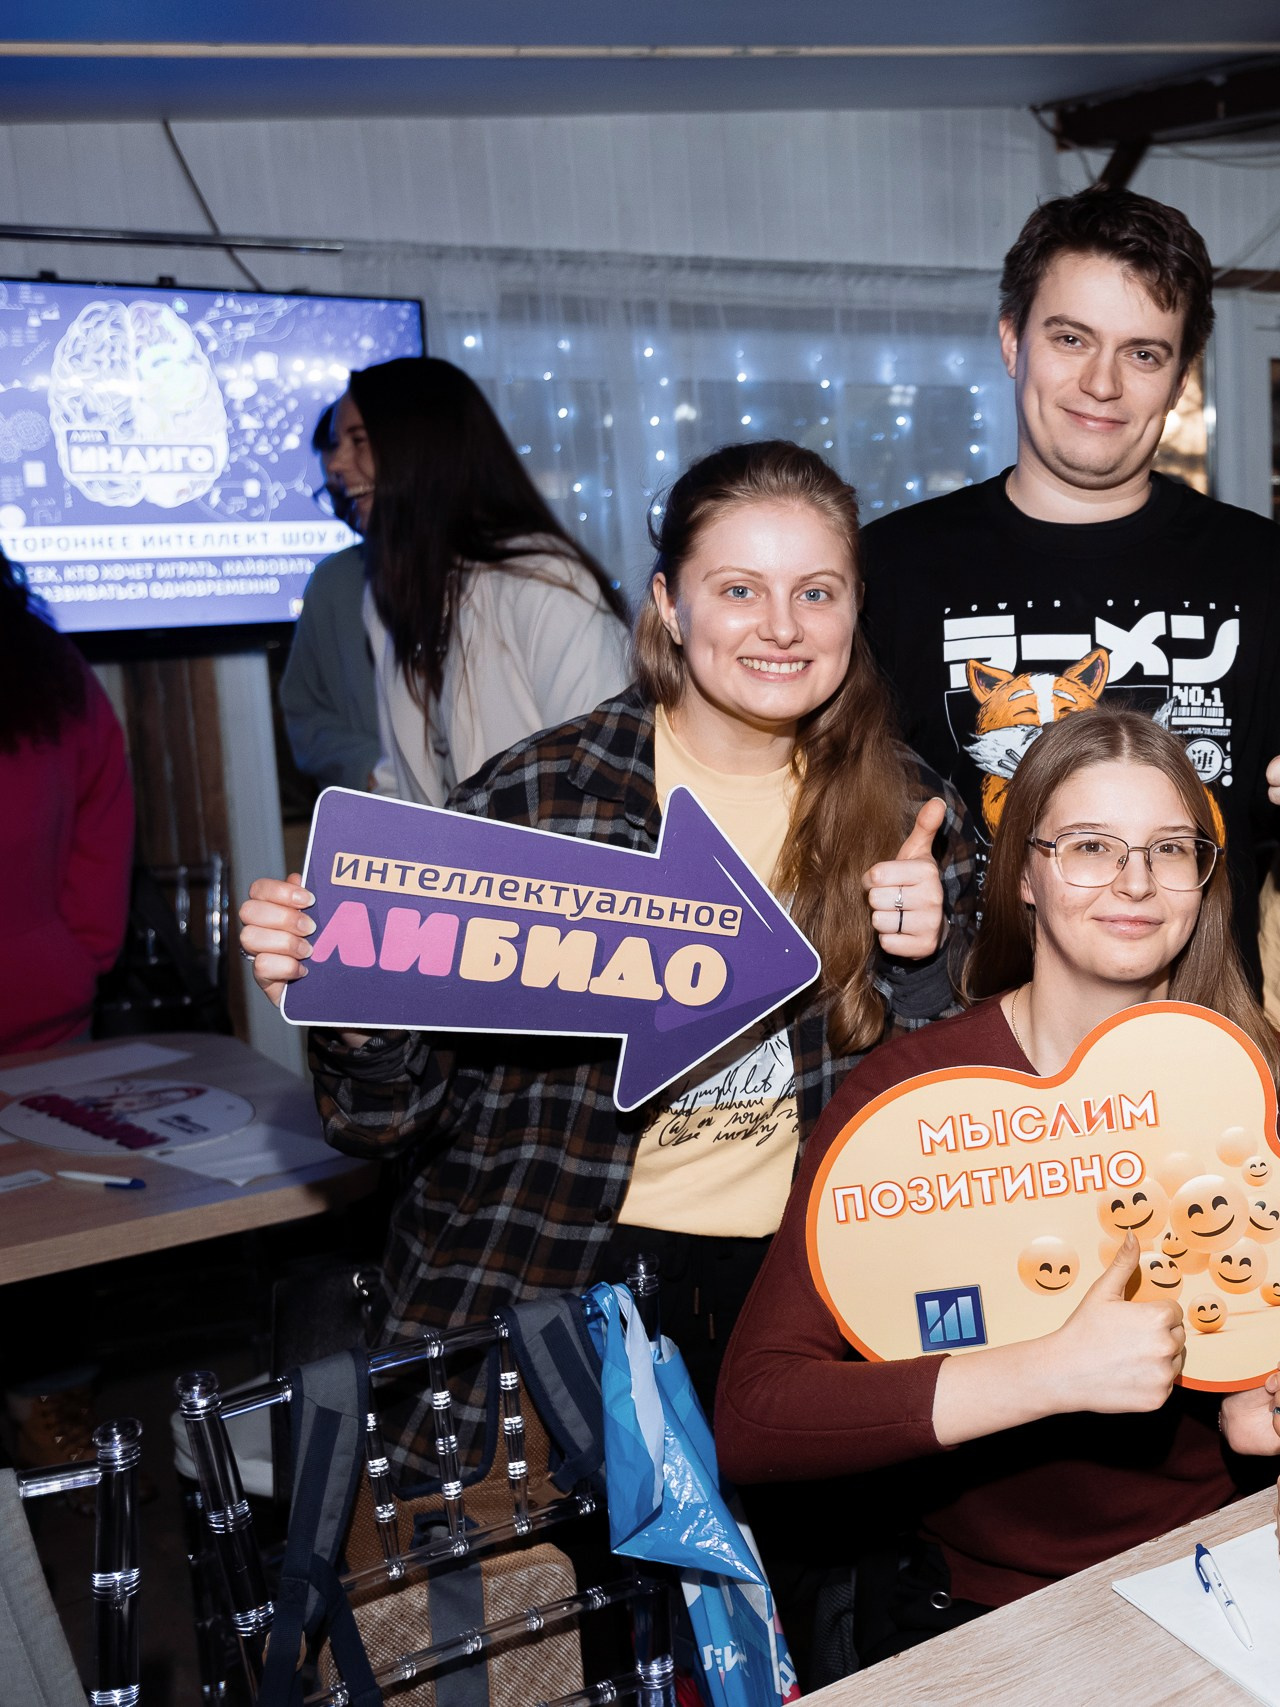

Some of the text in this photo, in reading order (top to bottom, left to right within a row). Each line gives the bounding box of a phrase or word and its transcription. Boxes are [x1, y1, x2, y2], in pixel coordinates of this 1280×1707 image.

[70, 446, 215, 473] ИНДИГО
[64, 564, 99, 582] КТО
[101, 562, 155, 581] ХОЧЕТ
[150, 577, 280, 599] ОДНОВРЕМЕННО
[945, 599, 1240, 614] POWER OF THE
[1172, 686, 1224, 707] NO.1
[335, 855, 740, 931] интеллектуальное
[311, 900, 728, 1006] ЛИБИДО
[918, 1090, 1160, 1155] МЫСЛИМ
[832, 1150, 1146, 1224] ПОЗИТИВНО
